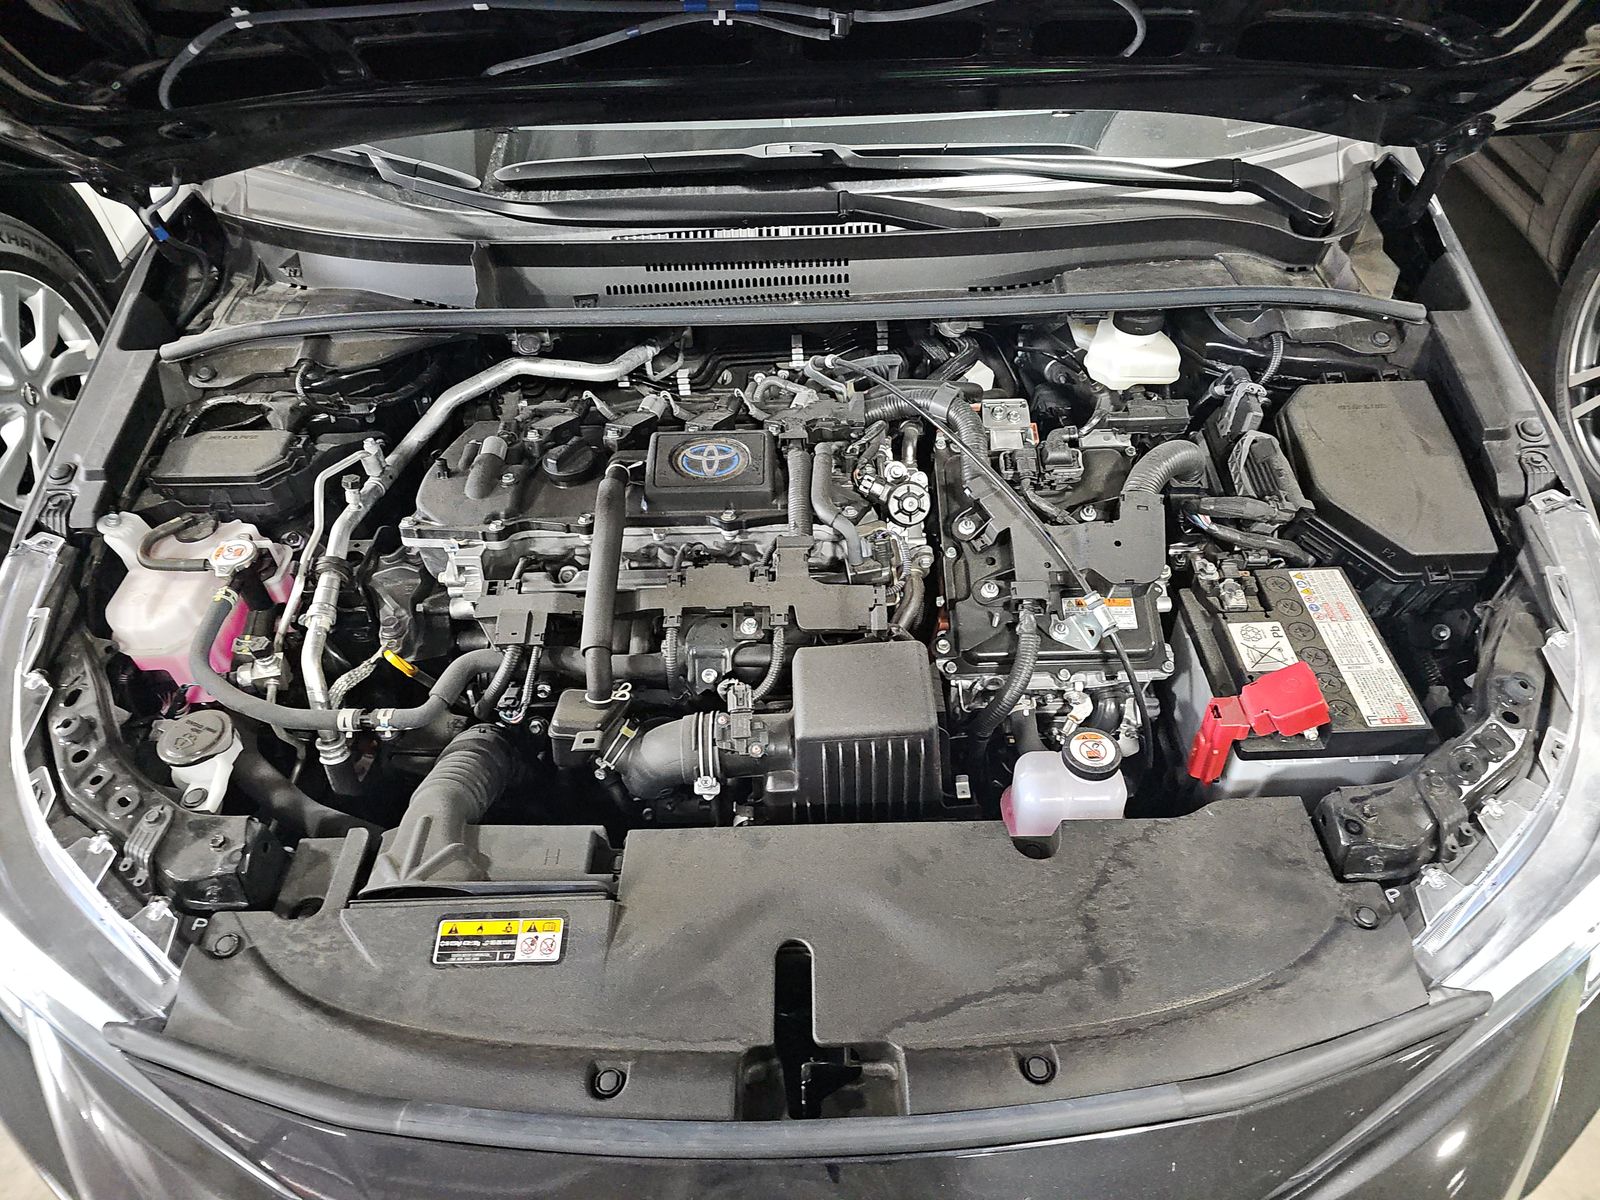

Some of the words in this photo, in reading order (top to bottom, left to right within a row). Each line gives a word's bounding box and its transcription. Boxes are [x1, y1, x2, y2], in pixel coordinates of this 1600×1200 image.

[1270, 625, 1283, 638] Pb
[1384, 888, 1400, 904] P
[191, 917, 208, 931] P
